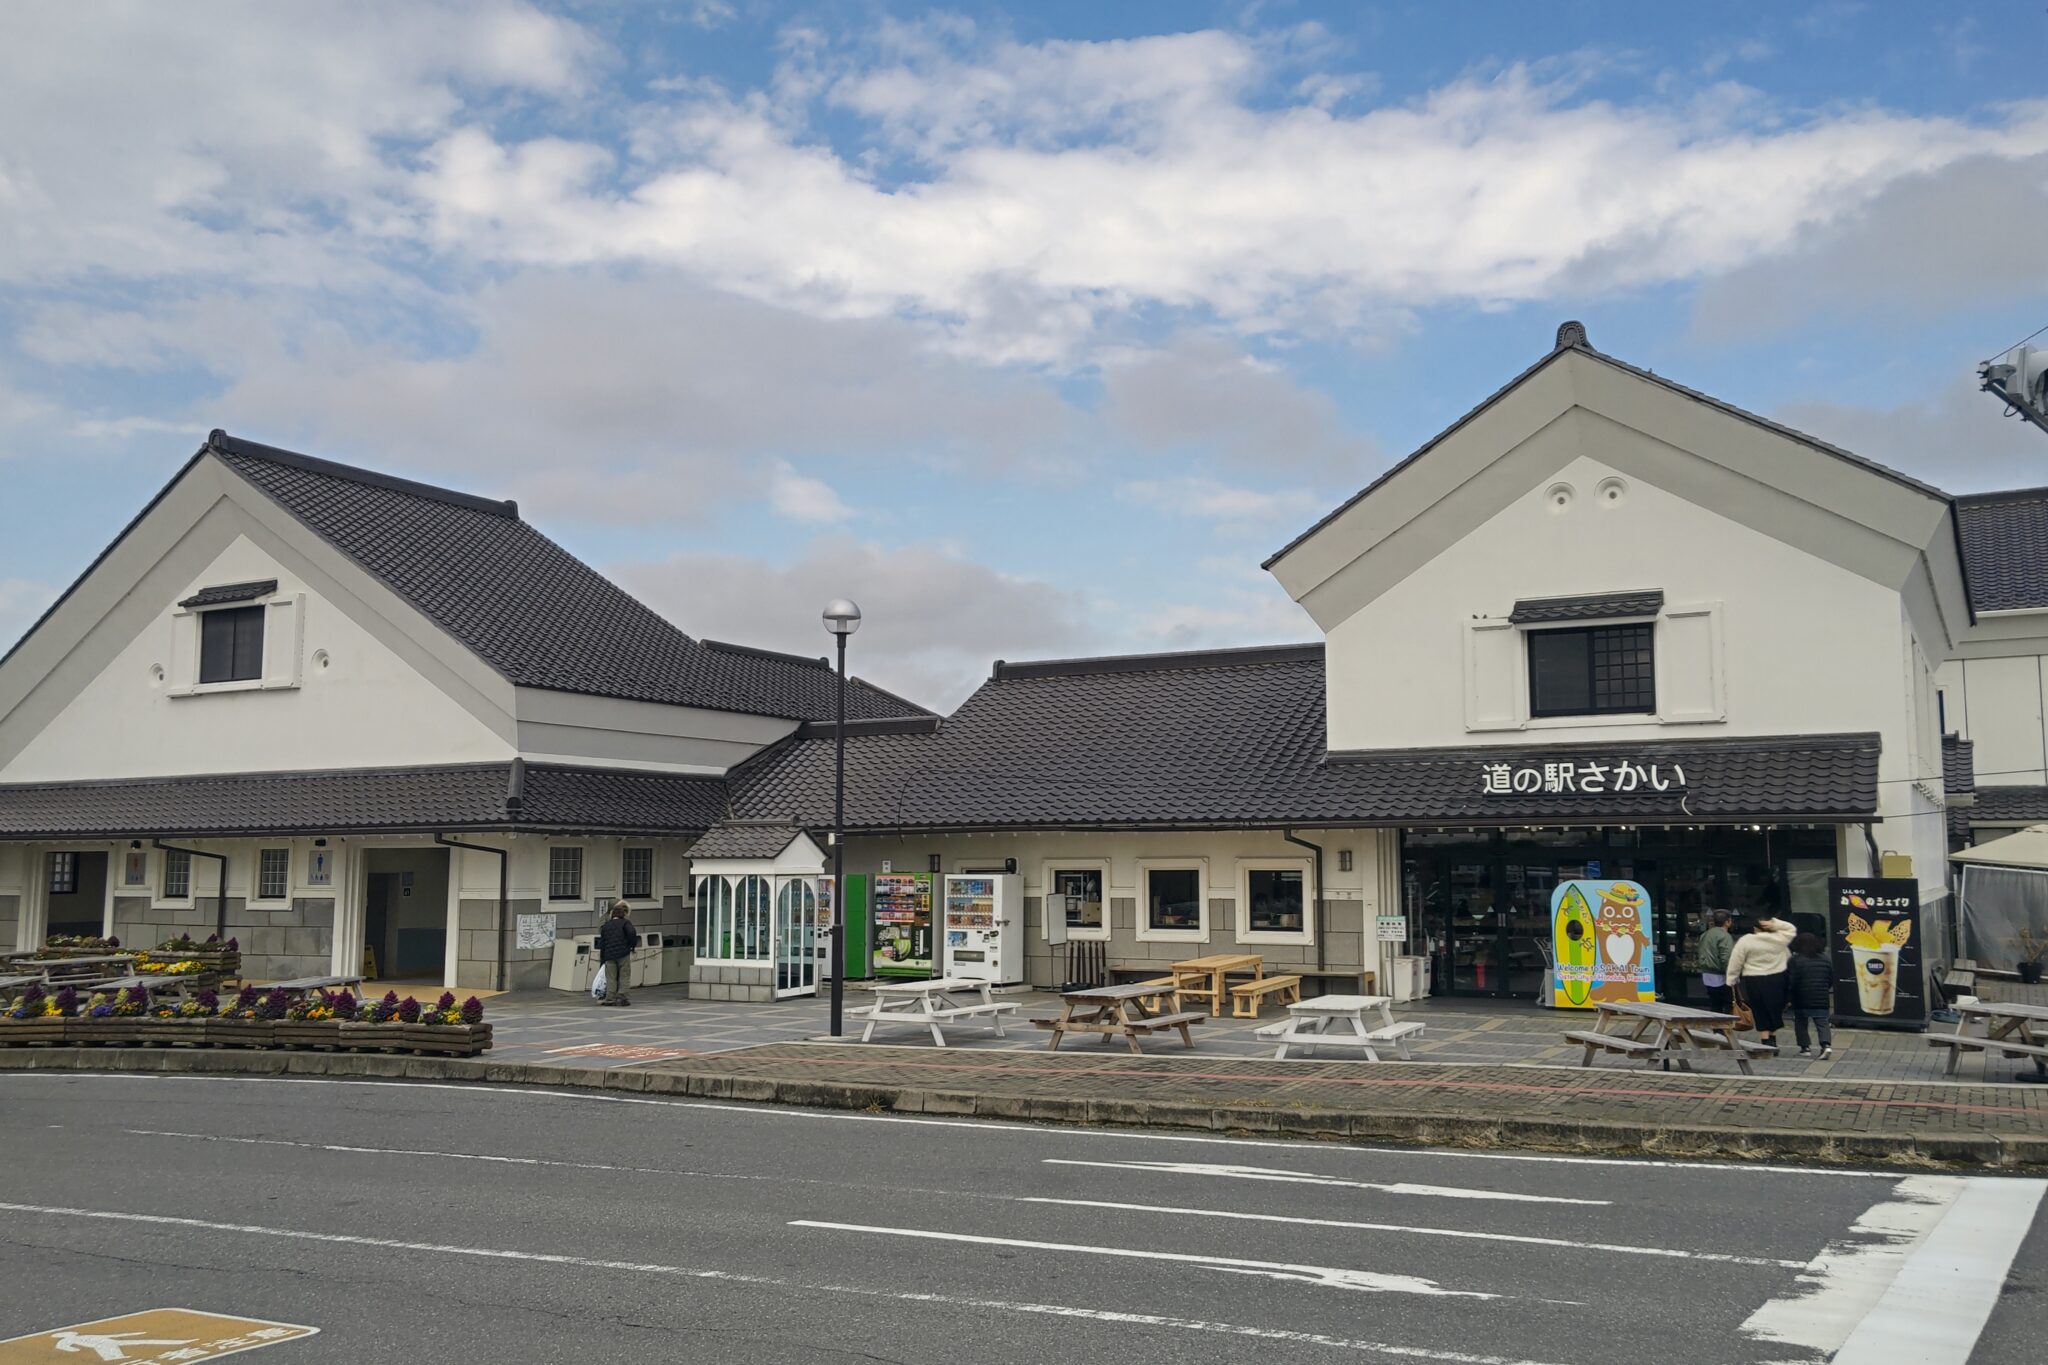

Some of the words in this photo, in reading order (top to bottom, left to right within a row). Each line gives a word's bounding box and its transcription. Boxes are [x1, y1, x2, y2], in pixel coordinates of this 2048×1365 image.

[1482, 761, 1686, 794] 道の駅さかい
[1558, 964, 1590, 972] Welcome
[1591, 964, 1599, 972] to
[1600, 964, 1629, 973] SAKAI
